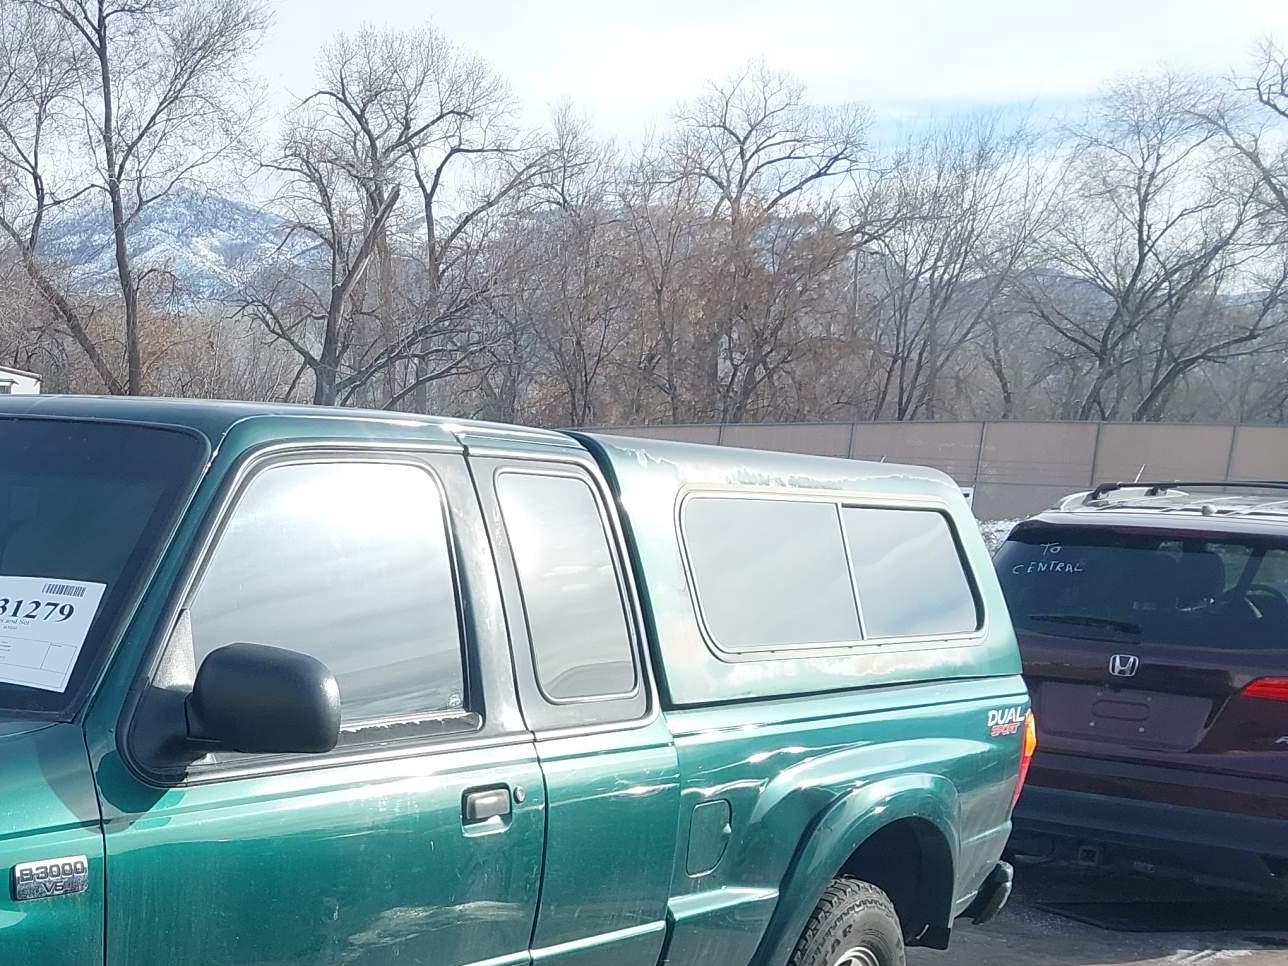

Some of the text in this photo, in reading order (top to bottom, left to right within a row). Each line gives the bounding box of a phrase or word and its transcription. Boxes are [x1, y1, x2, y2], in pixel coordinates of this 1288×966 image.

[1012, 560, 1084, 574] CENTRAL
[987, 706, 1025, 727] DUAL
[41, 881, 65, 895] V6
